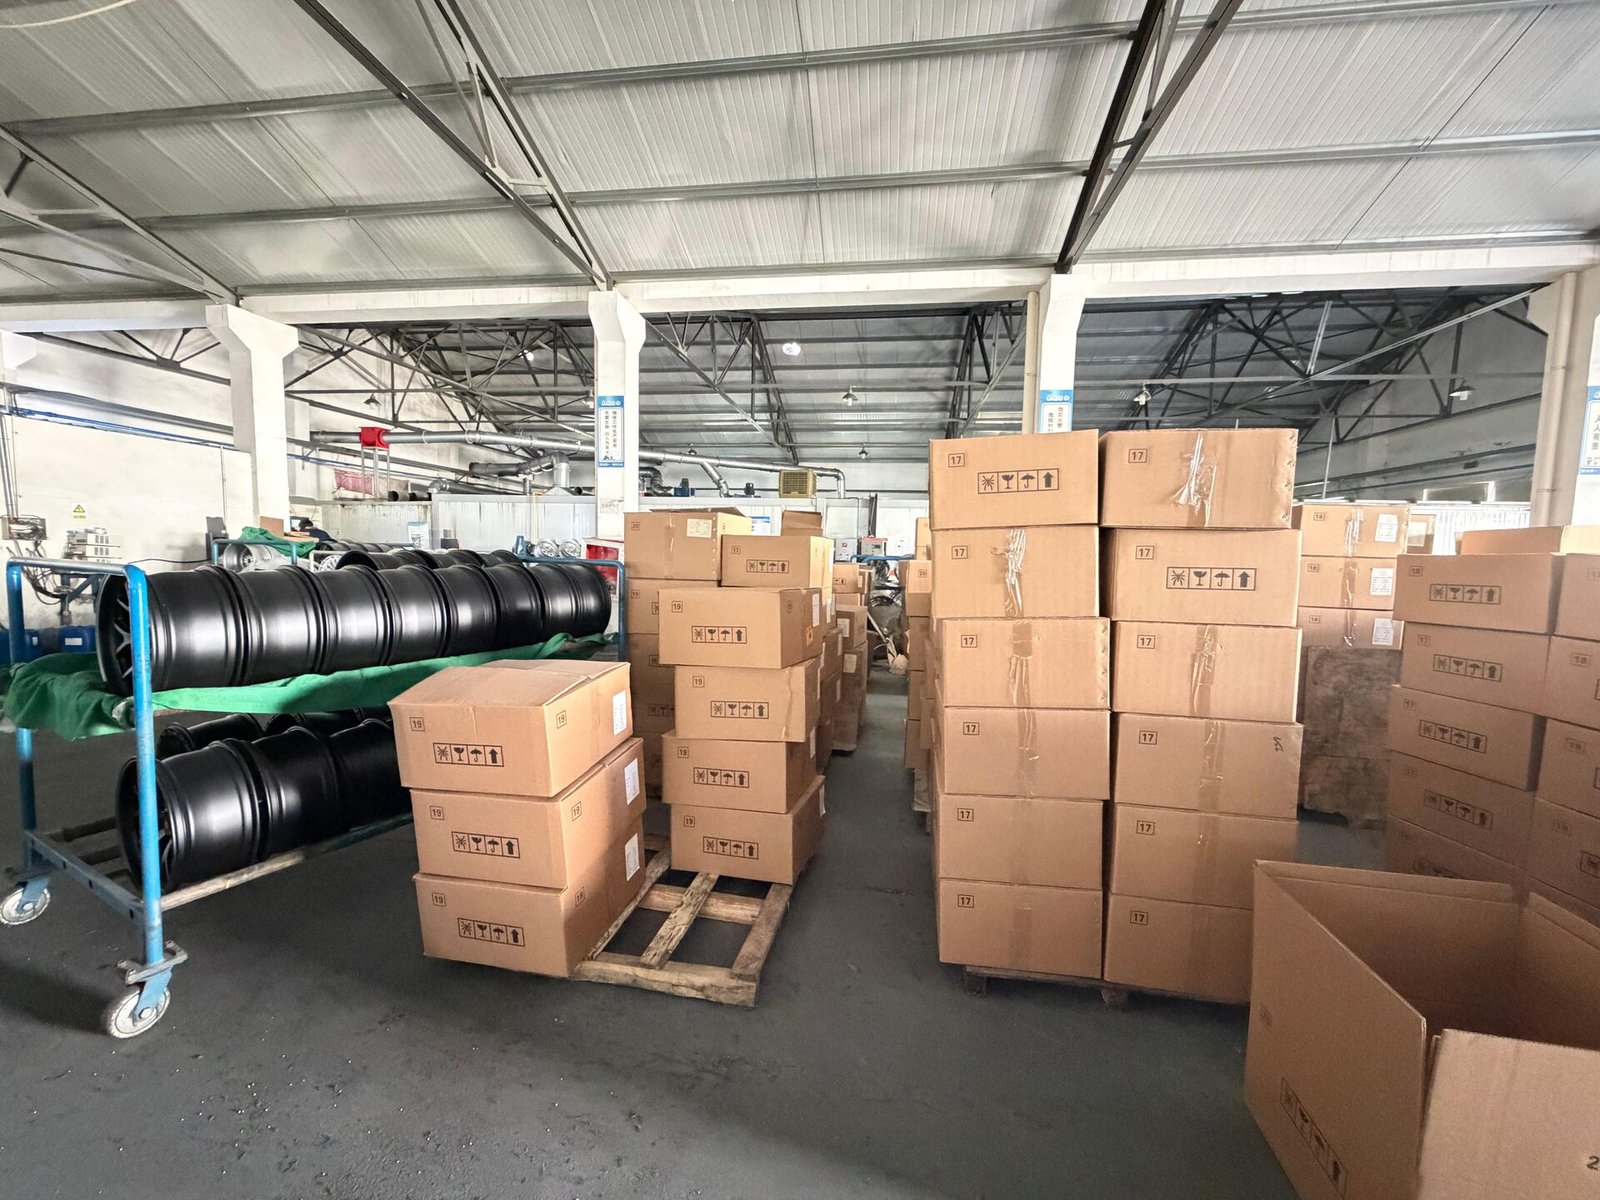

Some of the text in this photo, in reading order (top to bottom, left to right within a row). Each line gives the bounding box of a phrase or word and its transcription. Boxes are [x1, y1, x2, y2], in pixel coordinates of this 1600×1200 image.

[1131, 452, 1143, 460] 17
[951, 457, 962, 465] 17
[954, 549, 965, 557] 17
[1139, 549, 1150, 557] 17
[673, 602, 681, 611] 19
[963, 637, 975, 645] 17
[1140, 637, 1152, 646] 17
[694, 678, 703, 686] 19
[558, 715, 566, 724] 19
[412, 720, 422, 729] 19
[966, 724, 977, 733] 17
[1142, 733, 1154, 742] 17
[679, 749, 688, 757] 19
[432, 809, 442, 818] 19
[573, 806, 581, 816] 19
[960, 810, 971, 819] 17
[1139, 823, 1151, 833] 17
[434, 896, 444, 904] 19
[576, 892, 584, 902] 19
[960, 897, 971, 906] 17
[1133, 913, 1145, 922] 17
